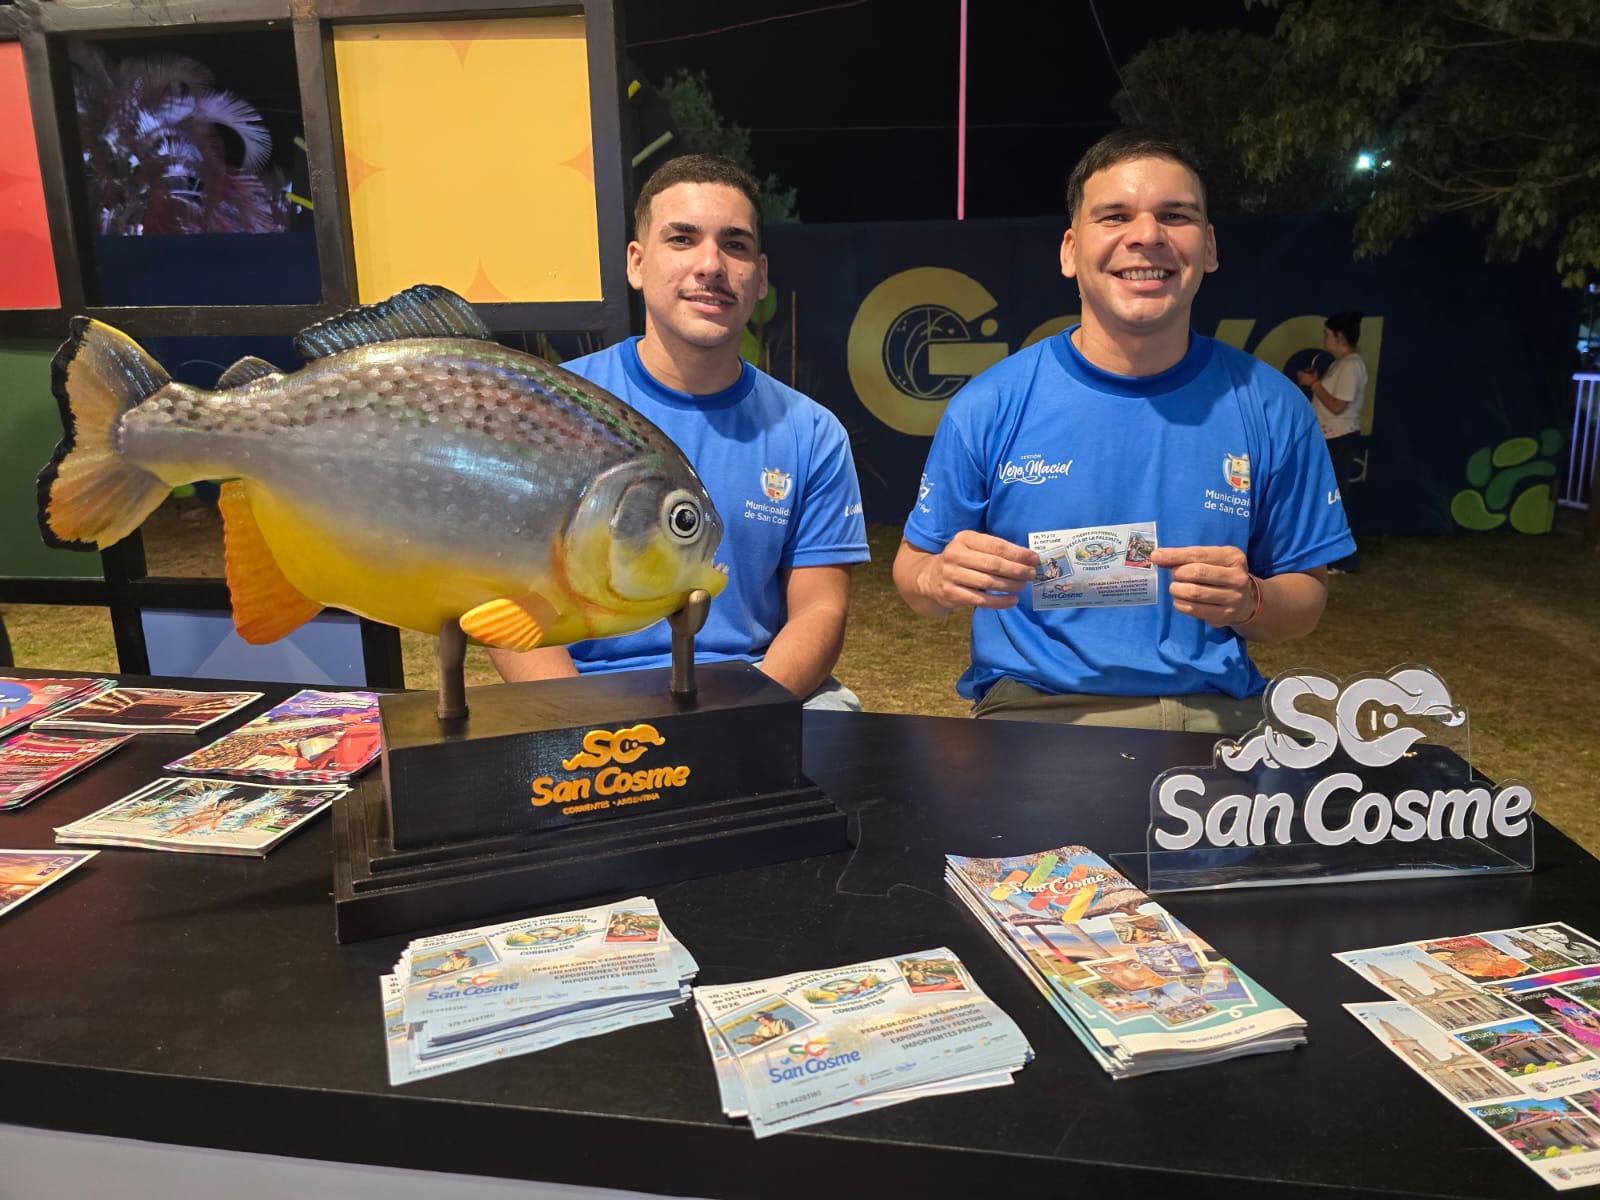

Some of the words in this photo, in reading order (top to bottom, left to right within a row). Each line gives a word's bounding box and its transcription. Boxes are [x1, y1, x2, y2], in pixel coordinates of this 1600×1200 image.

[998, 460, 1025, 480] Vero
[1025, 459, 1073, 478] Maciel
[1204, 488, 1250, 507] Municipal
[745, 499, 791, 517] Municipalid
[1204, 500, 1217, 510] de
[1218, 503, 1234, 515] San
[744, 509, 755, 519] de
[757, 512, 771, 523] San
[772, 515, 789, 525] Cos
[531, 776, 592, 806] San
[594, 765, 691, 796] Cosme
[562, 800, 611, 816] CORRIENTES
[616, 793, 661, 807] ARGENTINA
[1155, 774, 1294, 850] San
[1304, 773, 1532, 846] Cosme
[834, 968, 887, 978] PALOMETA
[427, 984, 461, 1001] San
[462, 981, 520, 997] Cosme
[832, 998, 886, 1015] CORRIENTES
[861, 1024, 886, 1034] PESCA
[897, 1016, 922, 1026] COSTA
[895, 1022, 924, 1034] MOTOR
[952, 1014, 988, 1028] FESTIVAL
[901, 1030, 958, 1050] IMPORTANTES
[959, 1021, 993, 1036] PREMIOS
[1461, 1030, 1497, 1042] Cultura
[769, 1066, 804, 1084] San
[805, 1050, 862, 1074] Cosme
[1475, 1106, 1515, 1118] Cultura
